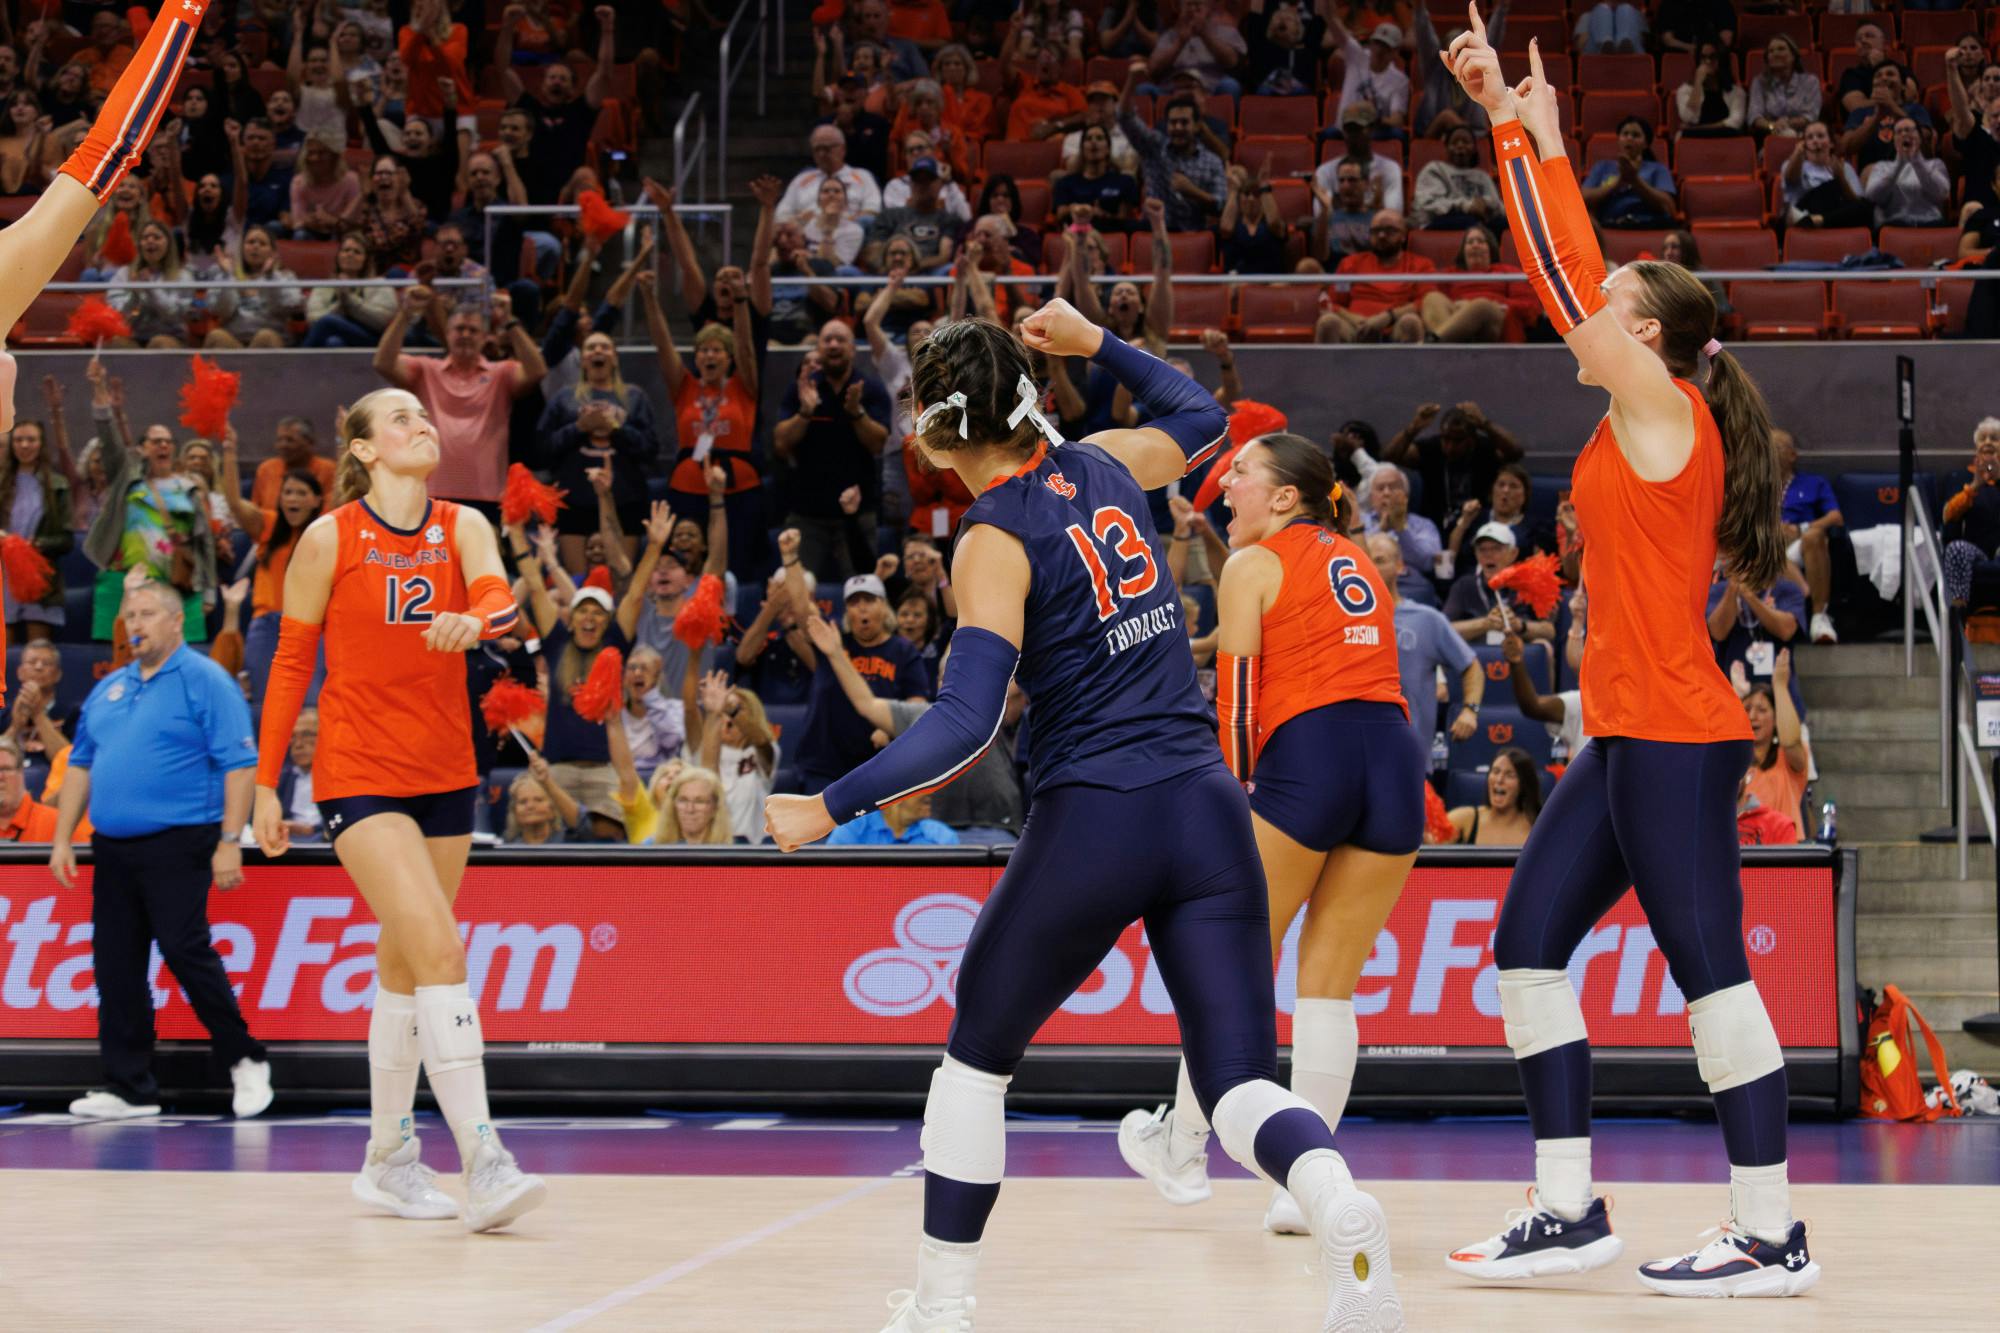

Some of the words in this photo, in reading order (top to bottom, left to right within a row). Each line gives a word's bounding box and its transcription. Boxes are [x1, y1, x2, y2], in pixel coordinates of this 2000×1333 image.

[364, 548, 448, 570] AUBURN
[1065, 506, 1158, 623] 13
[385, 575, 435, 625] 12
[1328, 556, 1376, 617] 6
[1105, 602, 1176, 656] THIBAULT
[1343, 625, 1379, 646] EDSON
[1367, 1045, 1447, 1056] DAKTRONICS
